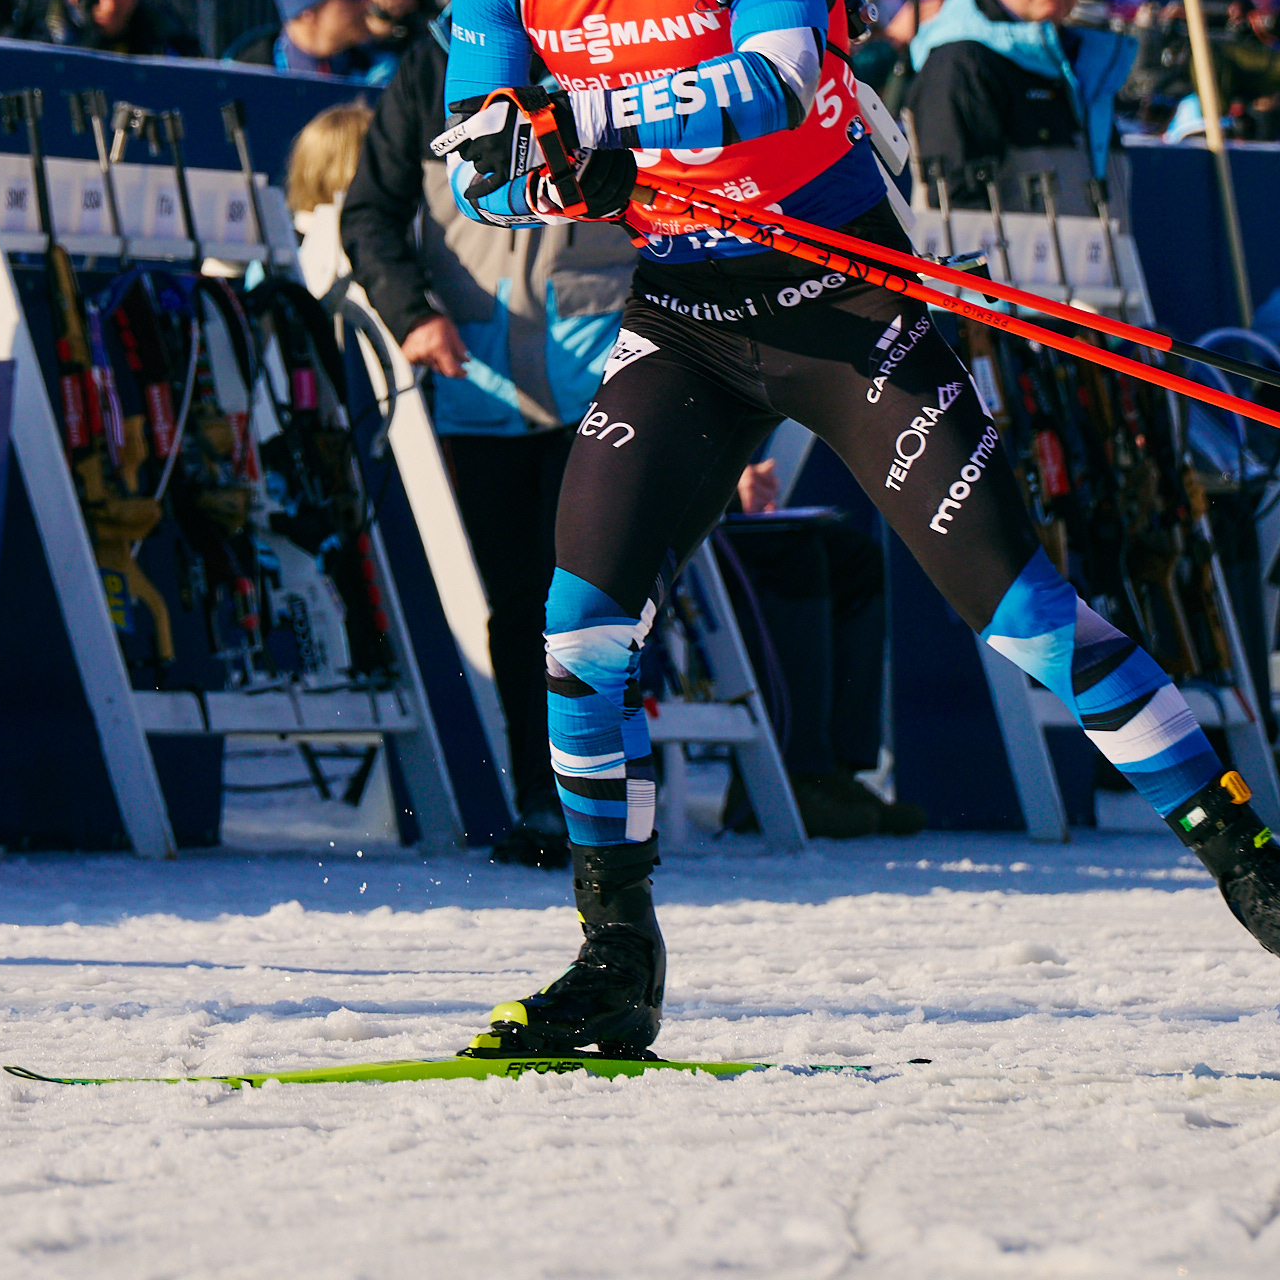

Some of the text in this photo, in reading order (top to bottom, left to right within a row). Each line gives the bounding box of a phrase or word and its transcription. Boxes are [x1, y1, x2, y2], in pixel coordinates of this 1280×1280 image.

[528, 12, 720, 65] VIESSMANN
[554, 72, 611, 92] Heat
[611, 58, 754, 129] EESTI
[650, 218, 683, 235] visit
[781, 274, 844, 305] PLG
[942, 298, 1009, 328] PREMIO 40
[866, 315, 931, 404] CARGLASS
[885, 406, 944, 492] TELORA
[929, 425, 999, 535] moomoo
